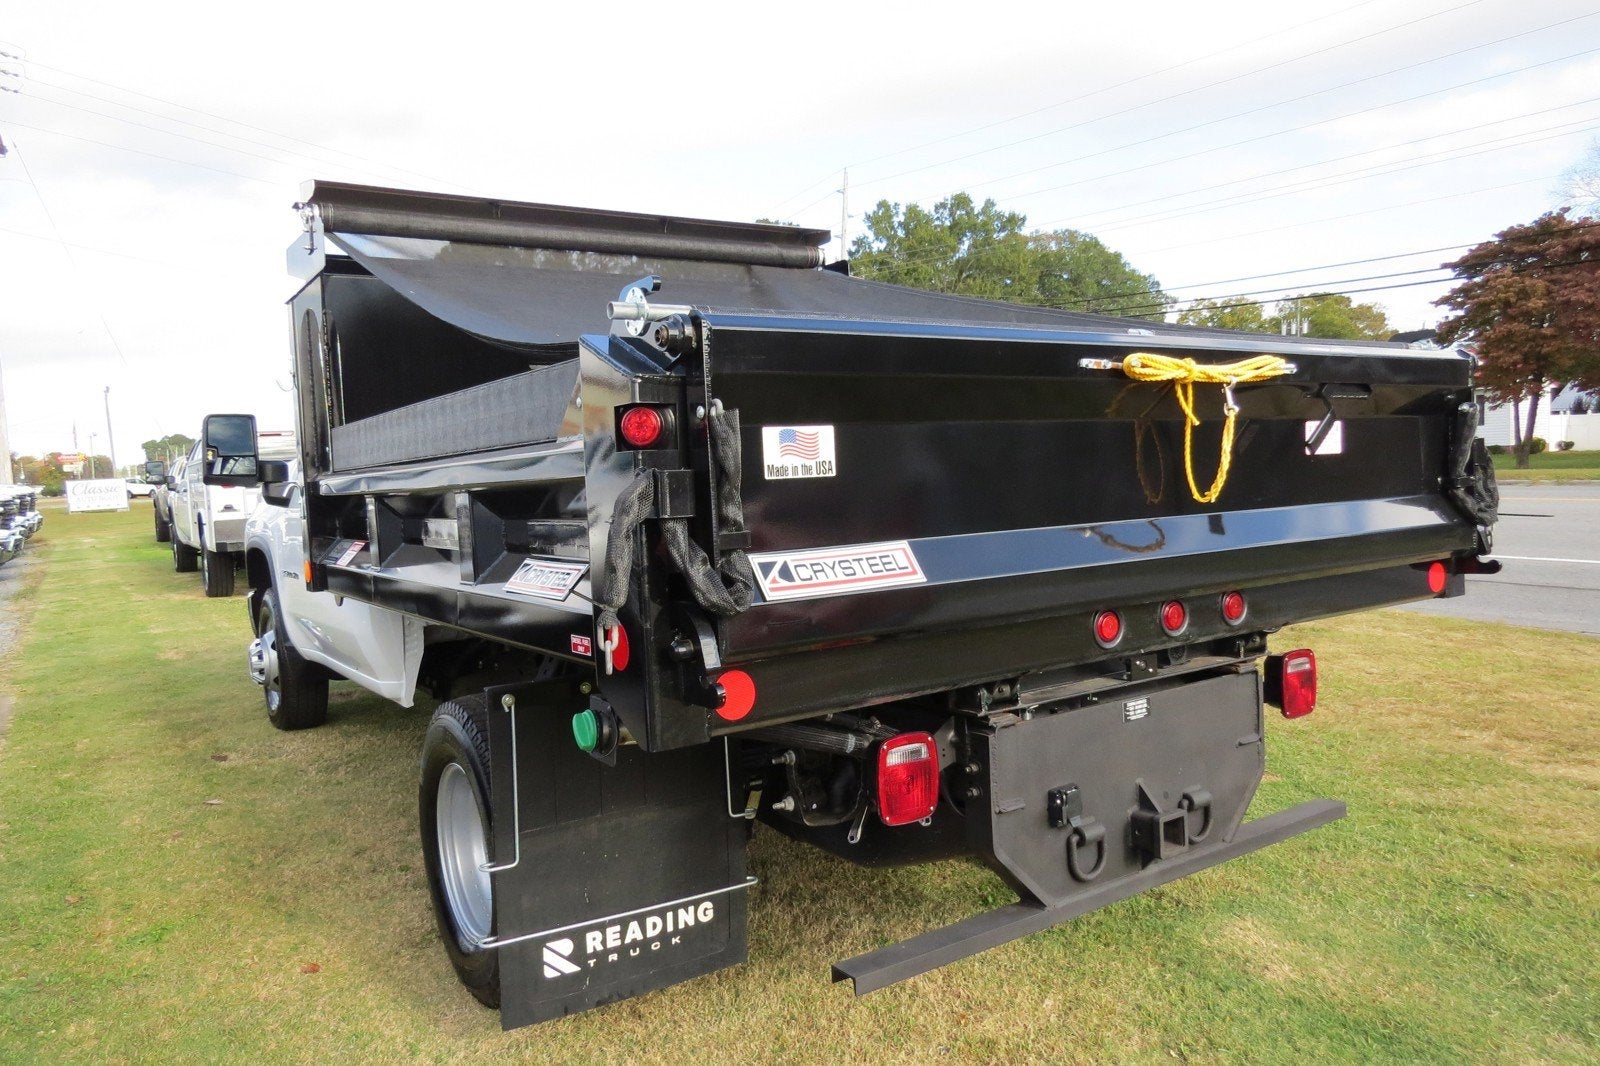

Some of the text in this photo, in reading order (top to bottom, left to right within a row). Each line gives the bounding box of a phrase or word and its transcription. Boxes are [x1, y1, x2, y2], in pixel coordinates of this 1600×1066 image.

[767, 460, 834, 478] Made in the USA
[71, 482, 119, 496] Classic
[521, 568, 573, 588] CRYSTEEL
[794, 554, 909, 582] CRYSTEEL
[585, 901, 714, 954] READING
[587, 935, 681, 968] TRUCK
